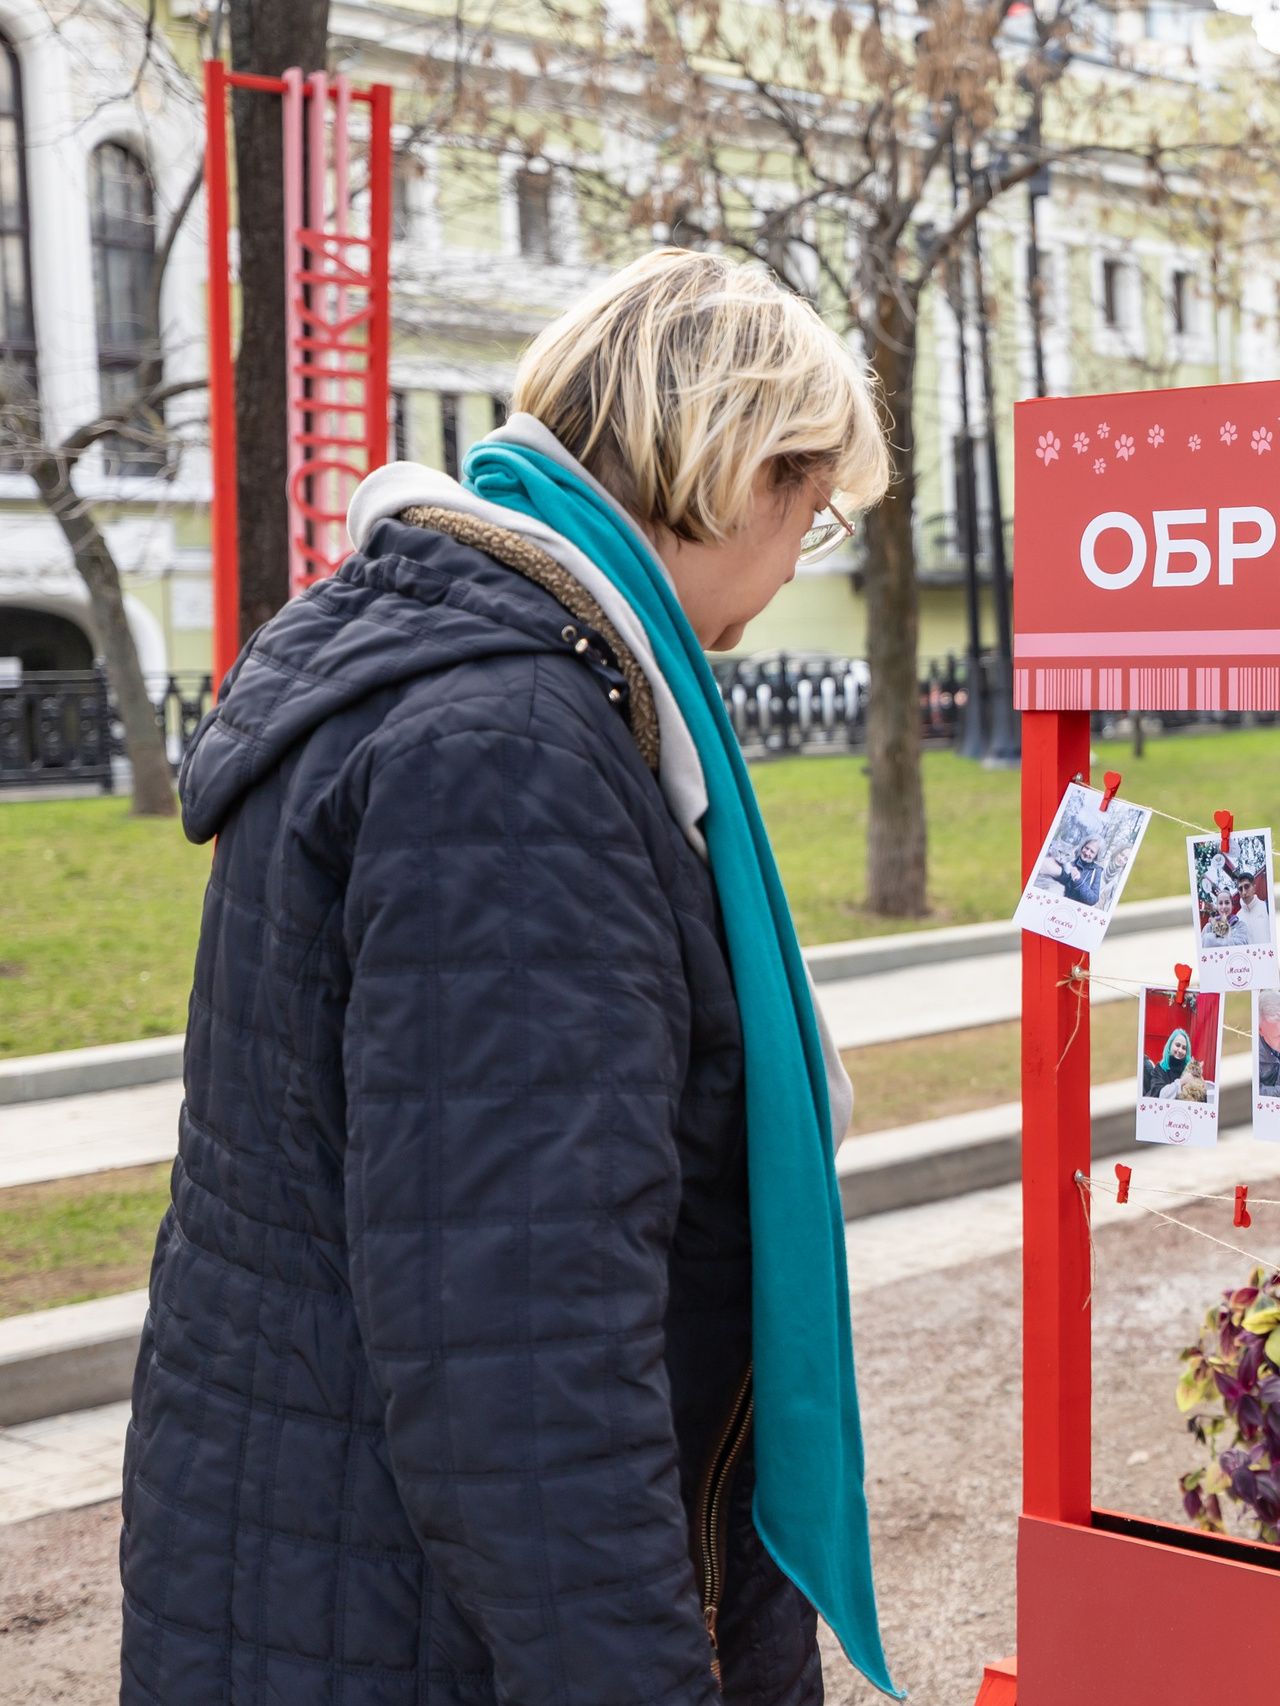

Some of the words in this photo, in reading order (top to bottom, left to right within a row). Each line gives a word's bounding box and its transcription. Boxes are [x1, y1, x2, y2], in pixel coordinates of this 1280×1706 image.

[1046, 916, 1073, 929] Москва
[1227, 966, 1250, 975] Москва
[1165, 1120, 1190, 1130] Москва
